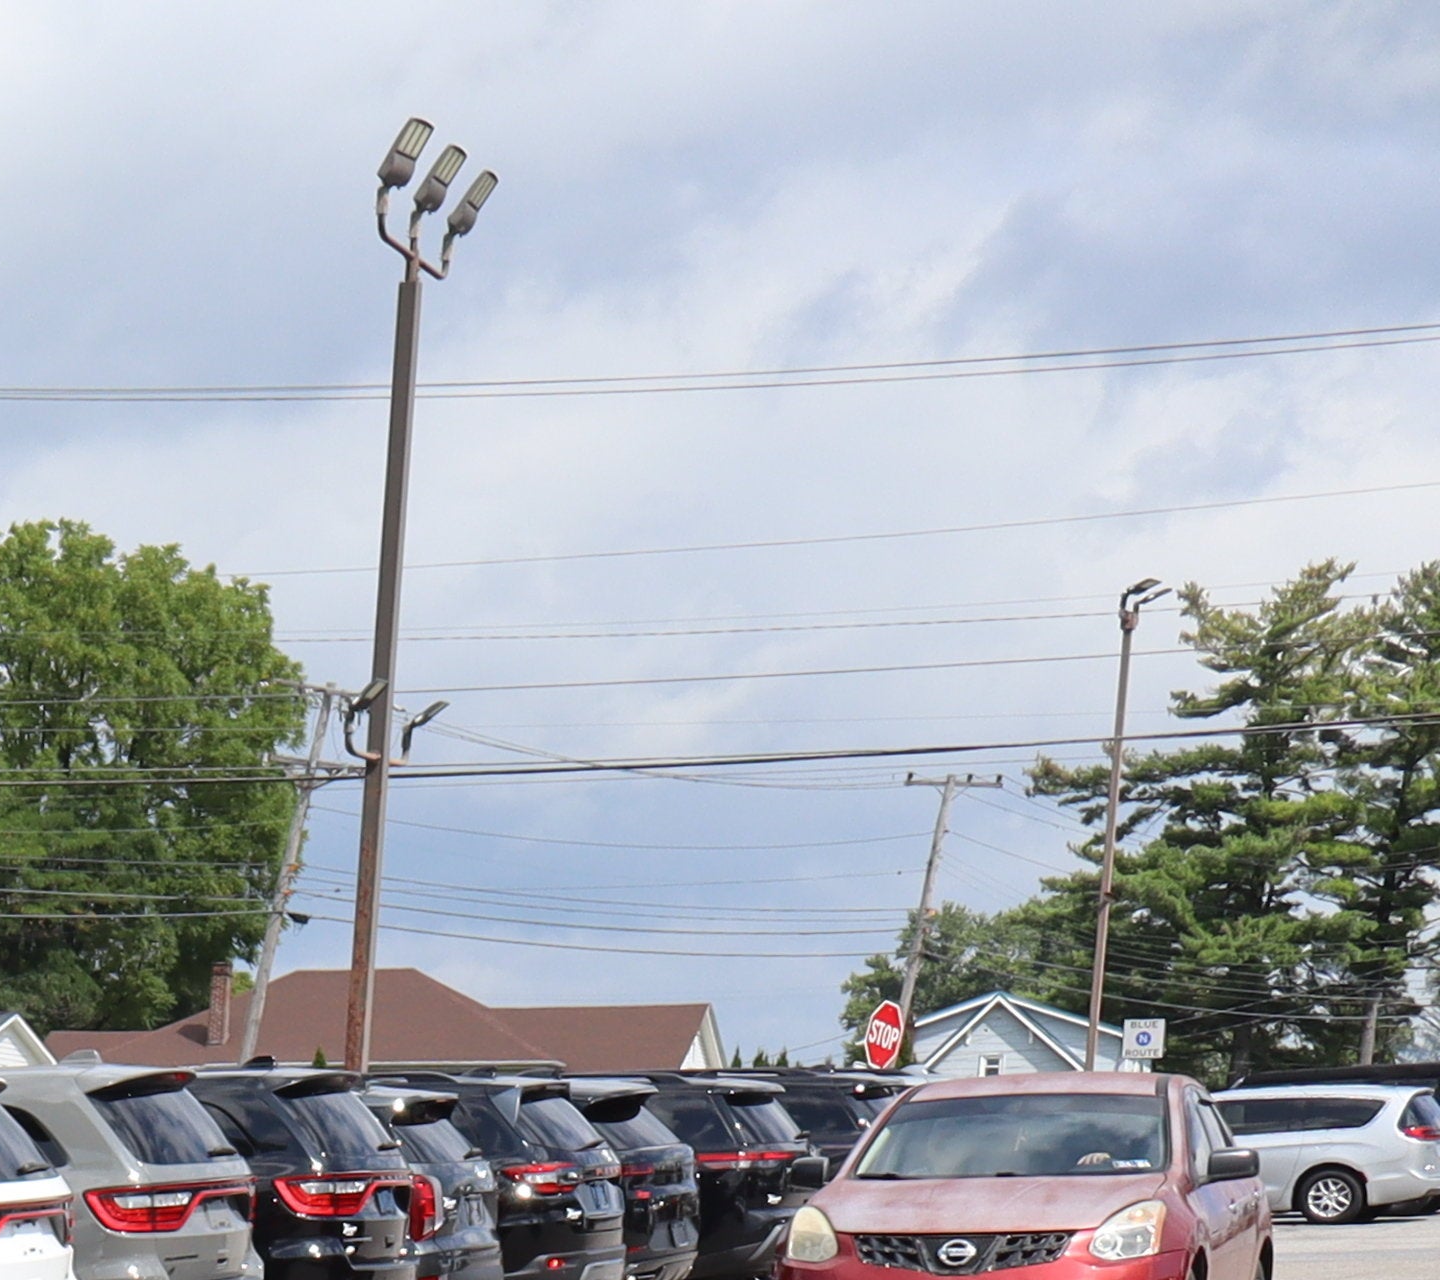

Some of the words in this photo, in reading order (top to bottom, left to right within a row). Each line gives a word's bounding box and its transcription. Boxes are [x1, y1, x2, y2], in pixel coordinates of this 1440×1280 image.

[1130, 1020, 1158, 1029] BLUE
[869, 1019, 900, 1050] STOP
[1125, 1048, 1160, 1057] ROUTE
